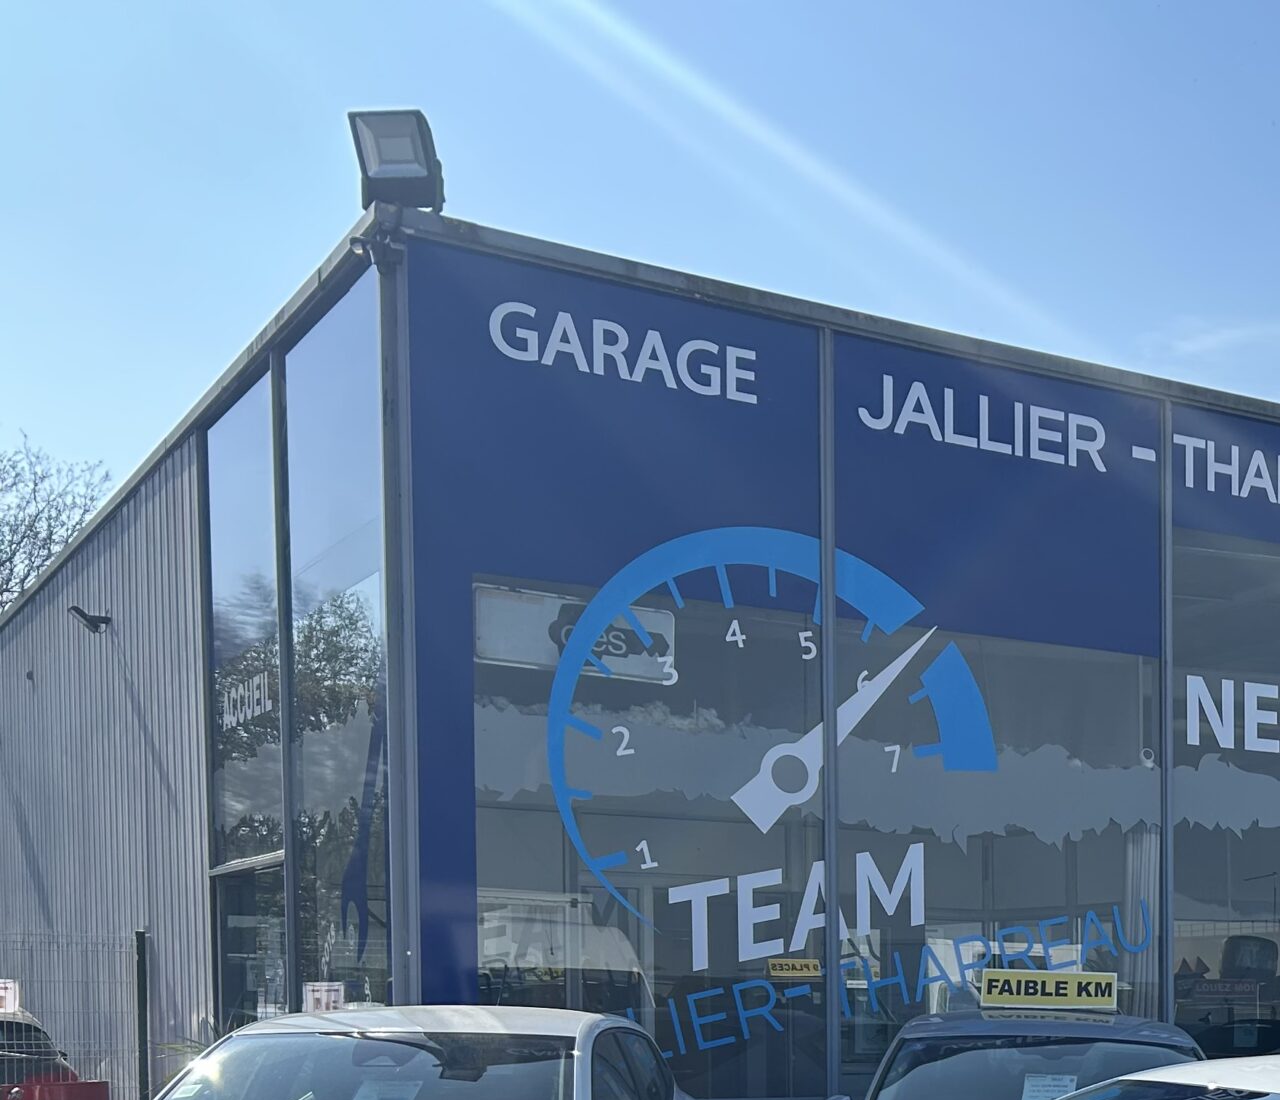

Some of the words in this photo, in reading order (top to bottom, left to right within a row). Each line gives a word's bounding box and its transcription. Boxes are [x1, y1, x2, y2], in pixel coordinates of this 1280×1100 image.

[489, 302, 758, 404] GARAGE
[858, 374, 1107, 472] JALLIER
[725, 619, 746, 648] 4
[798, 631, 817, 660] 5
[657, 656, 678, 686] 3
[222, 671, 273, 730] ACCUEIL
[611, 725, 635, 756] 2
[884, 744, 900, 773] 7
[635, 840, 659, 870] 1
[668, 842, 926, 972] TEAM
[986, 978, 1069, 997] FAIBLE
[1076, 981, 1113, 998] KM
